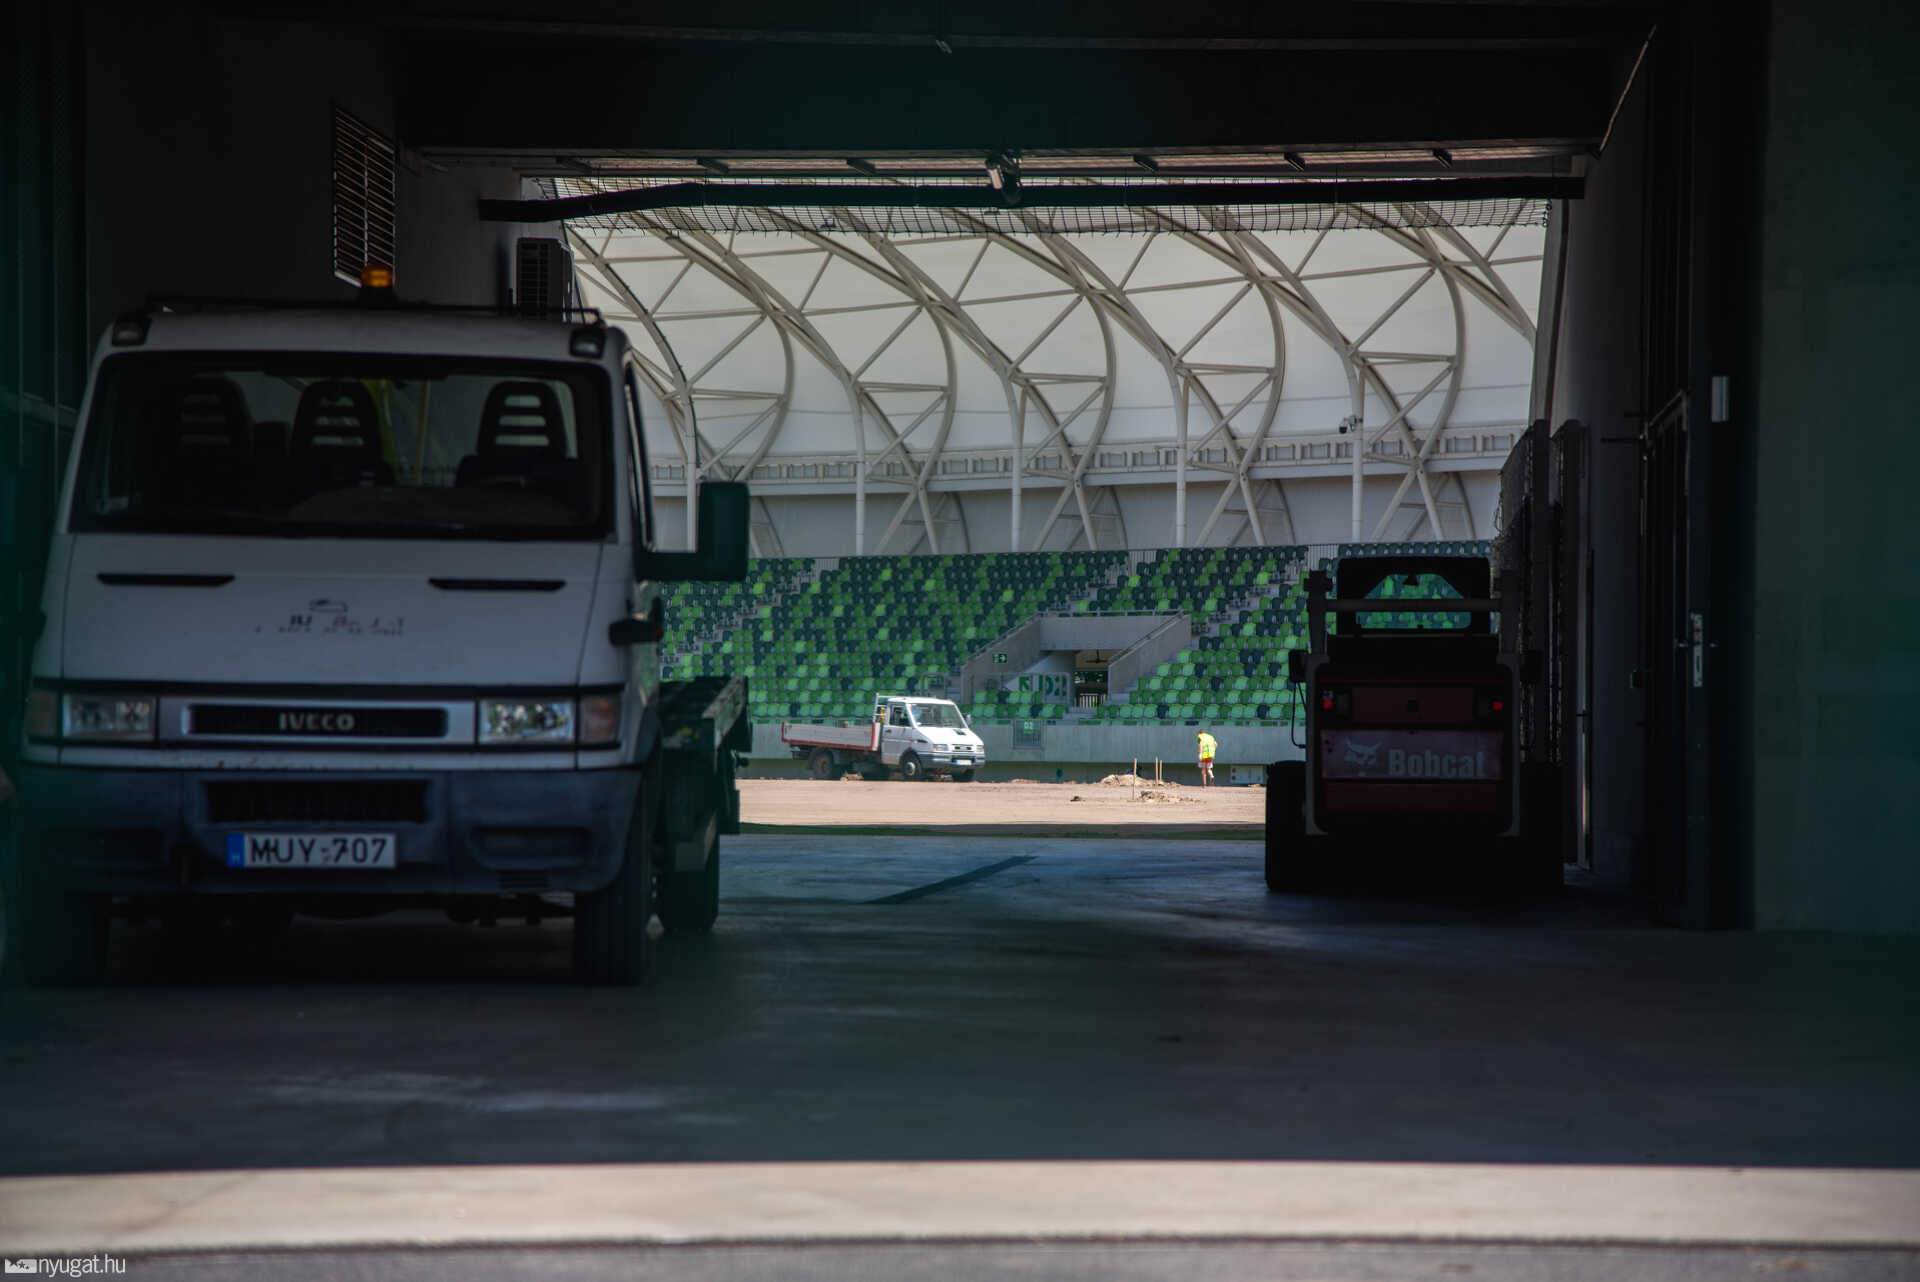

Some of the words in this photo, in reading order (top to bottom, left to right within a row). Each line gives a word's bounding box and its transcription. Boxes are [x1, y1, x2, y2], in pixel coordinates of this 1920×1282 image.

[278, 711, 356, 731] IVECO
[1387, 748, 1486, 777] Bobcat
[251, 838, 387, 863] MUY-707
